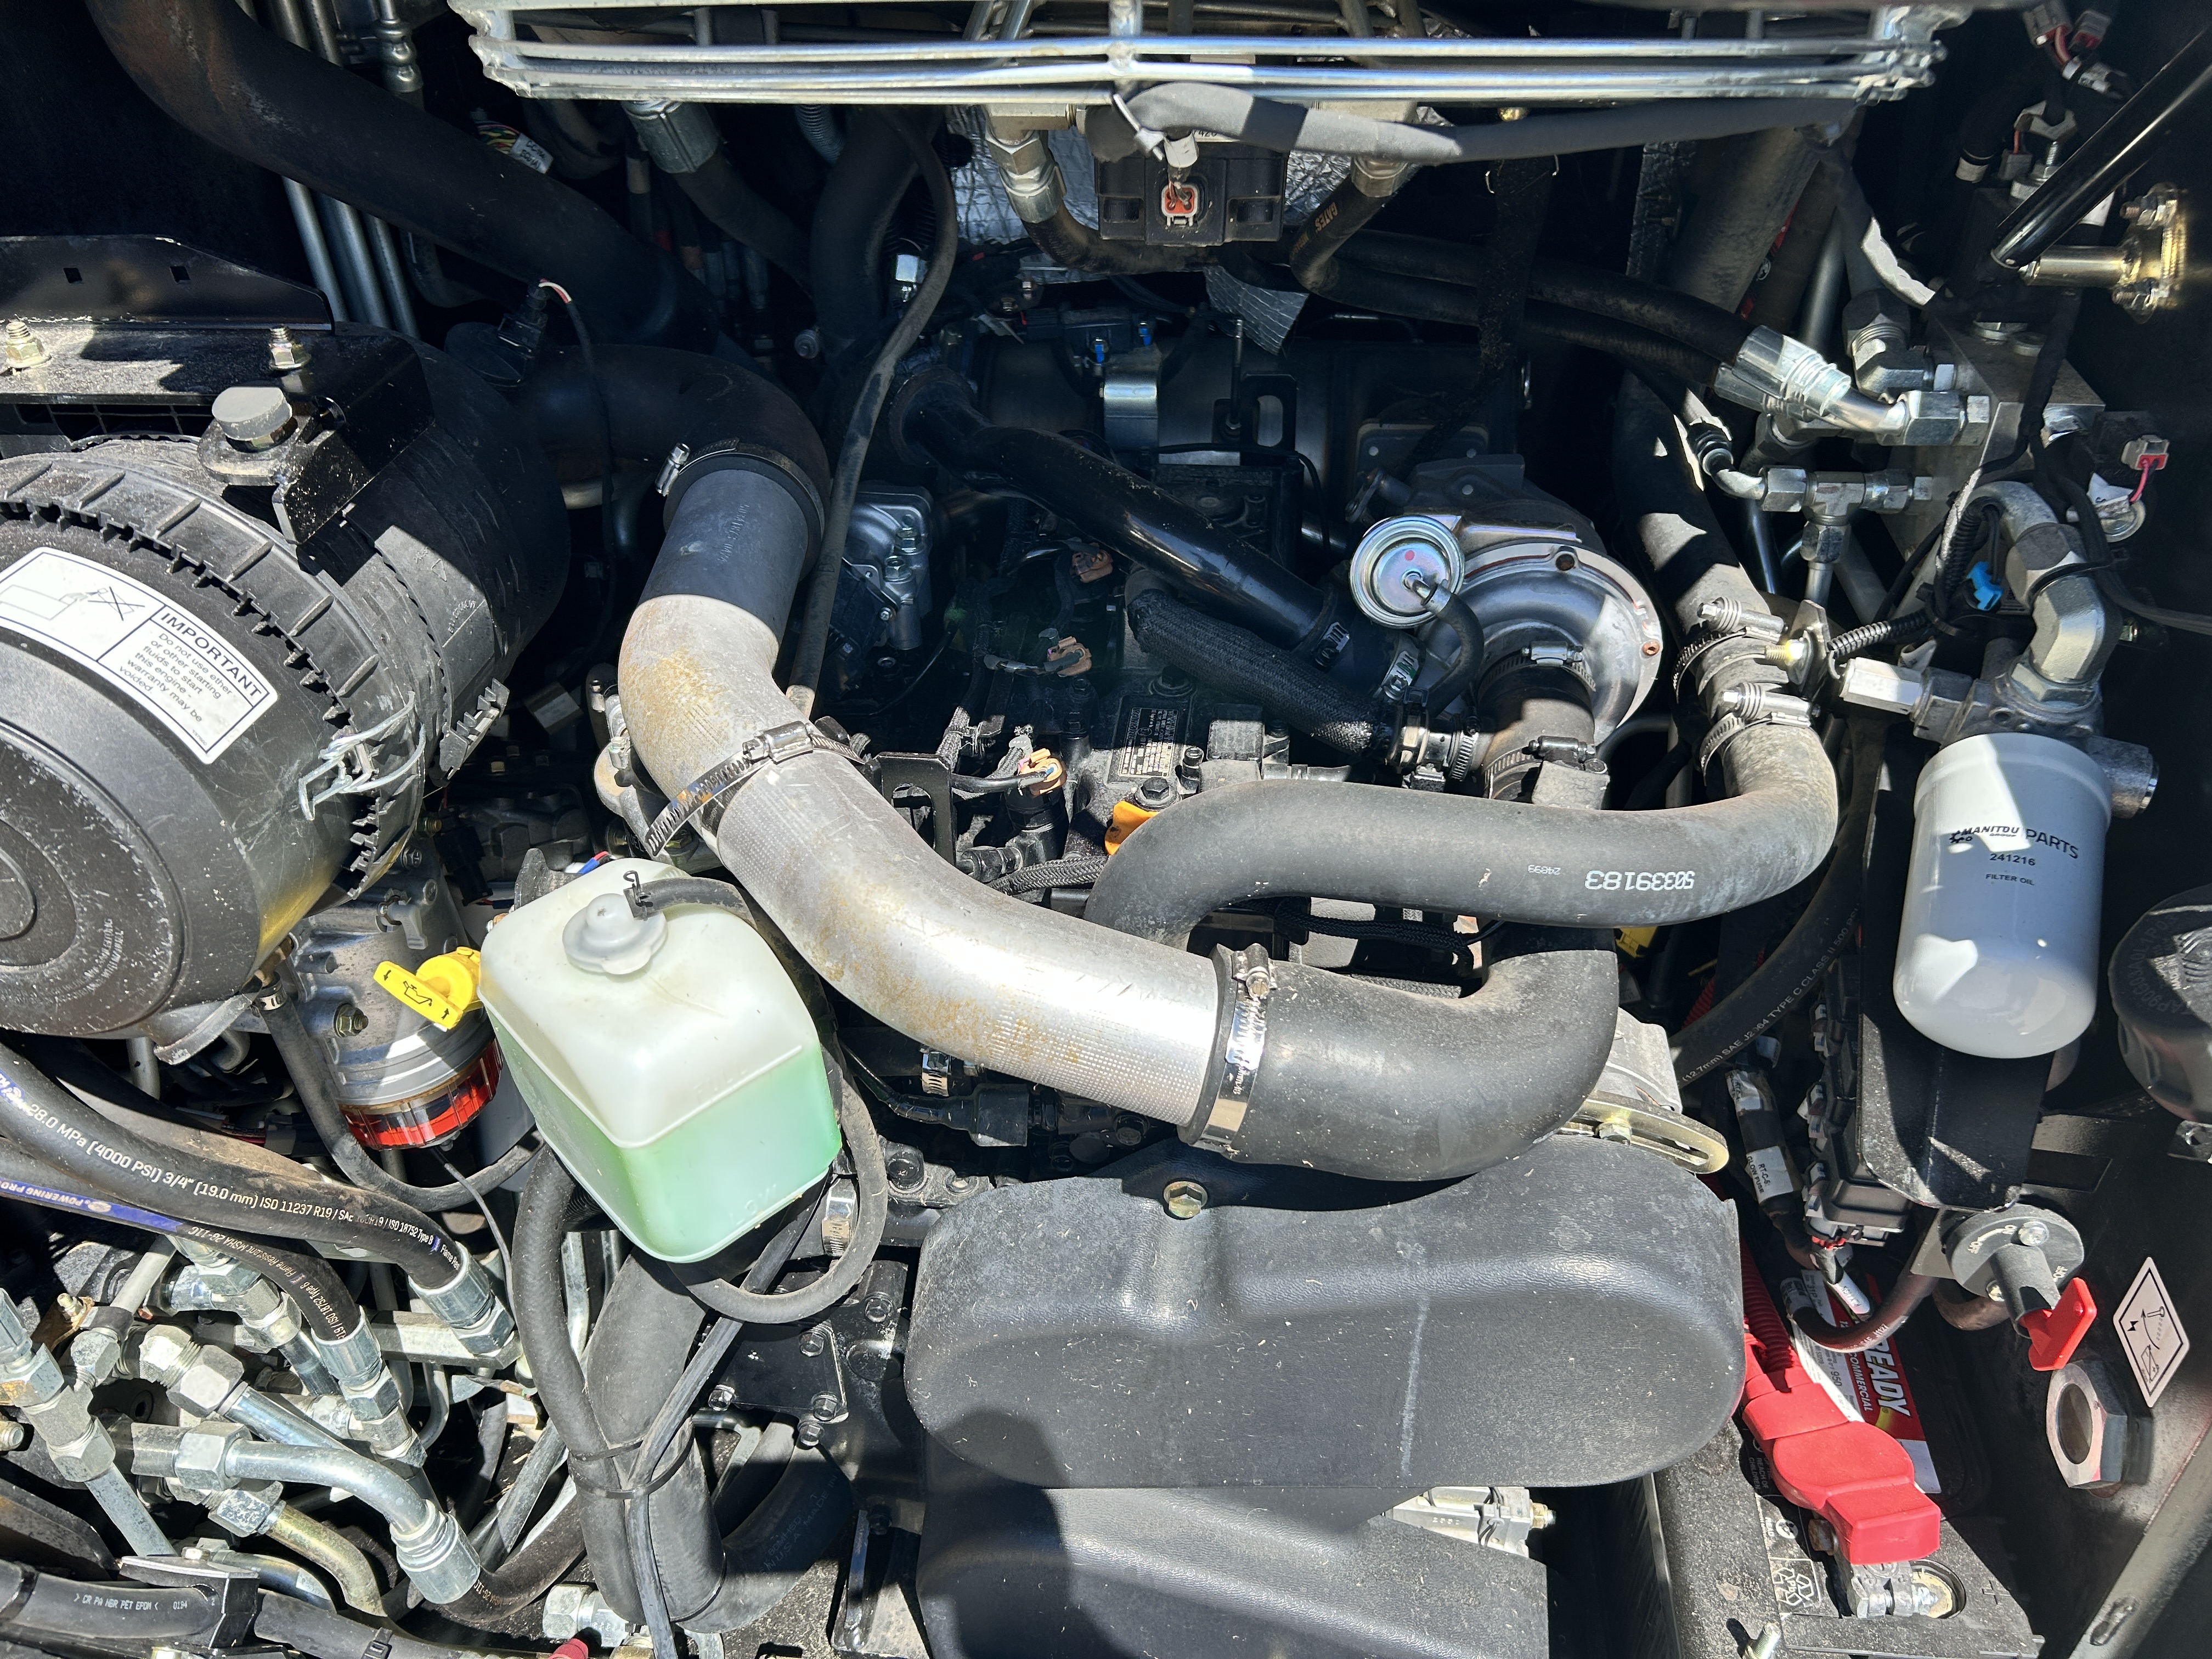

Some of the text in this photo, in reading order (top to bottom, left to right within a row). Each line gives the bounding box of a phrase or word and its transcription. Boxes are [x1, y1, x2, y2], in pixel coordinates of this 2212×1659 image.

[1314, 201, 1338, 232] GATES
[159, 633, 233, 695] Do not use ether
[161, 613, 262, 697] IMPORTANT
[120, 666, 154, 694] voided.
[135, 652, 154, 667] this
[155, 667, 187, 693] engine
[143, 646, 202, 694] fluids to start
[151, 640, 221, 699] or other starting
[127, 659, 202, 722] warranty may be
[1960, 826, 2079, 859] MANITOU PARTS
[1989, 853, 2035, 866] 241216
[1584, 870, 1695, 891] 50339183
[1985, 873, 2017, 882] FILTER
[1682, 1054, 1723, 1082] (12.7mm)
[1722, 1040, 1743, 1056] SAE
[1744, 1018, 1769, 1041] J264
[1767, 996, 1795, 1018] TYPE
[1793, 987, 1802, 996] C
[1801, 955, 1830, 986] CLASS
[28, 1104, 59, 1128] 28.0
[57, 1123, 88, 1147] MPa
[86, 1141, 132, 1169] (4000
[131, 1160, 162, 1183] PSI)
[193, 1182, 229, 1199] (19.0
[230, 1192, 258, 1209] mm)
[259, 1197, 279, 1210] ISO
[280, 1201, 313, 1215] 11237
[388, 1219, 399, 1231] ISO
[399, 1222, 419, 1237] 18752
[417, 1226, 429, 1243] Type
[440, 1244, 453, 1263] Flame
[1747, 1155, 1764, 1194] GLOW FUSE
[0, 1180, 83, 1206] POWERING PRO
[223, 1237, 249, 1251] MSHA
[246, 1245, 280, 1266] Resistant
[1967, 1241, 1983, 1254] OFF
[276, 1261, 297, 1277] Flame
[2053, 1266, 2068, 1278] OFF
[306, 1284, 320, 1300] Type
[313, 1296, 332, 1314] 18752
[326, 1313, 338, 1325] ISO
[1830, 1372, 1843, 1387] 950
[1850, 1352, 1873, 1411] COMMERCIAL
[1748, 1457, 1760, 1491] CHILDREN
[1756, 1457, 1769, 1489] REACH OF
[1765, 1517, 1775, 1537] READ
[1786, 1579, 1796, 1592] Pb
[120, 1600, 133, 1609] PET
